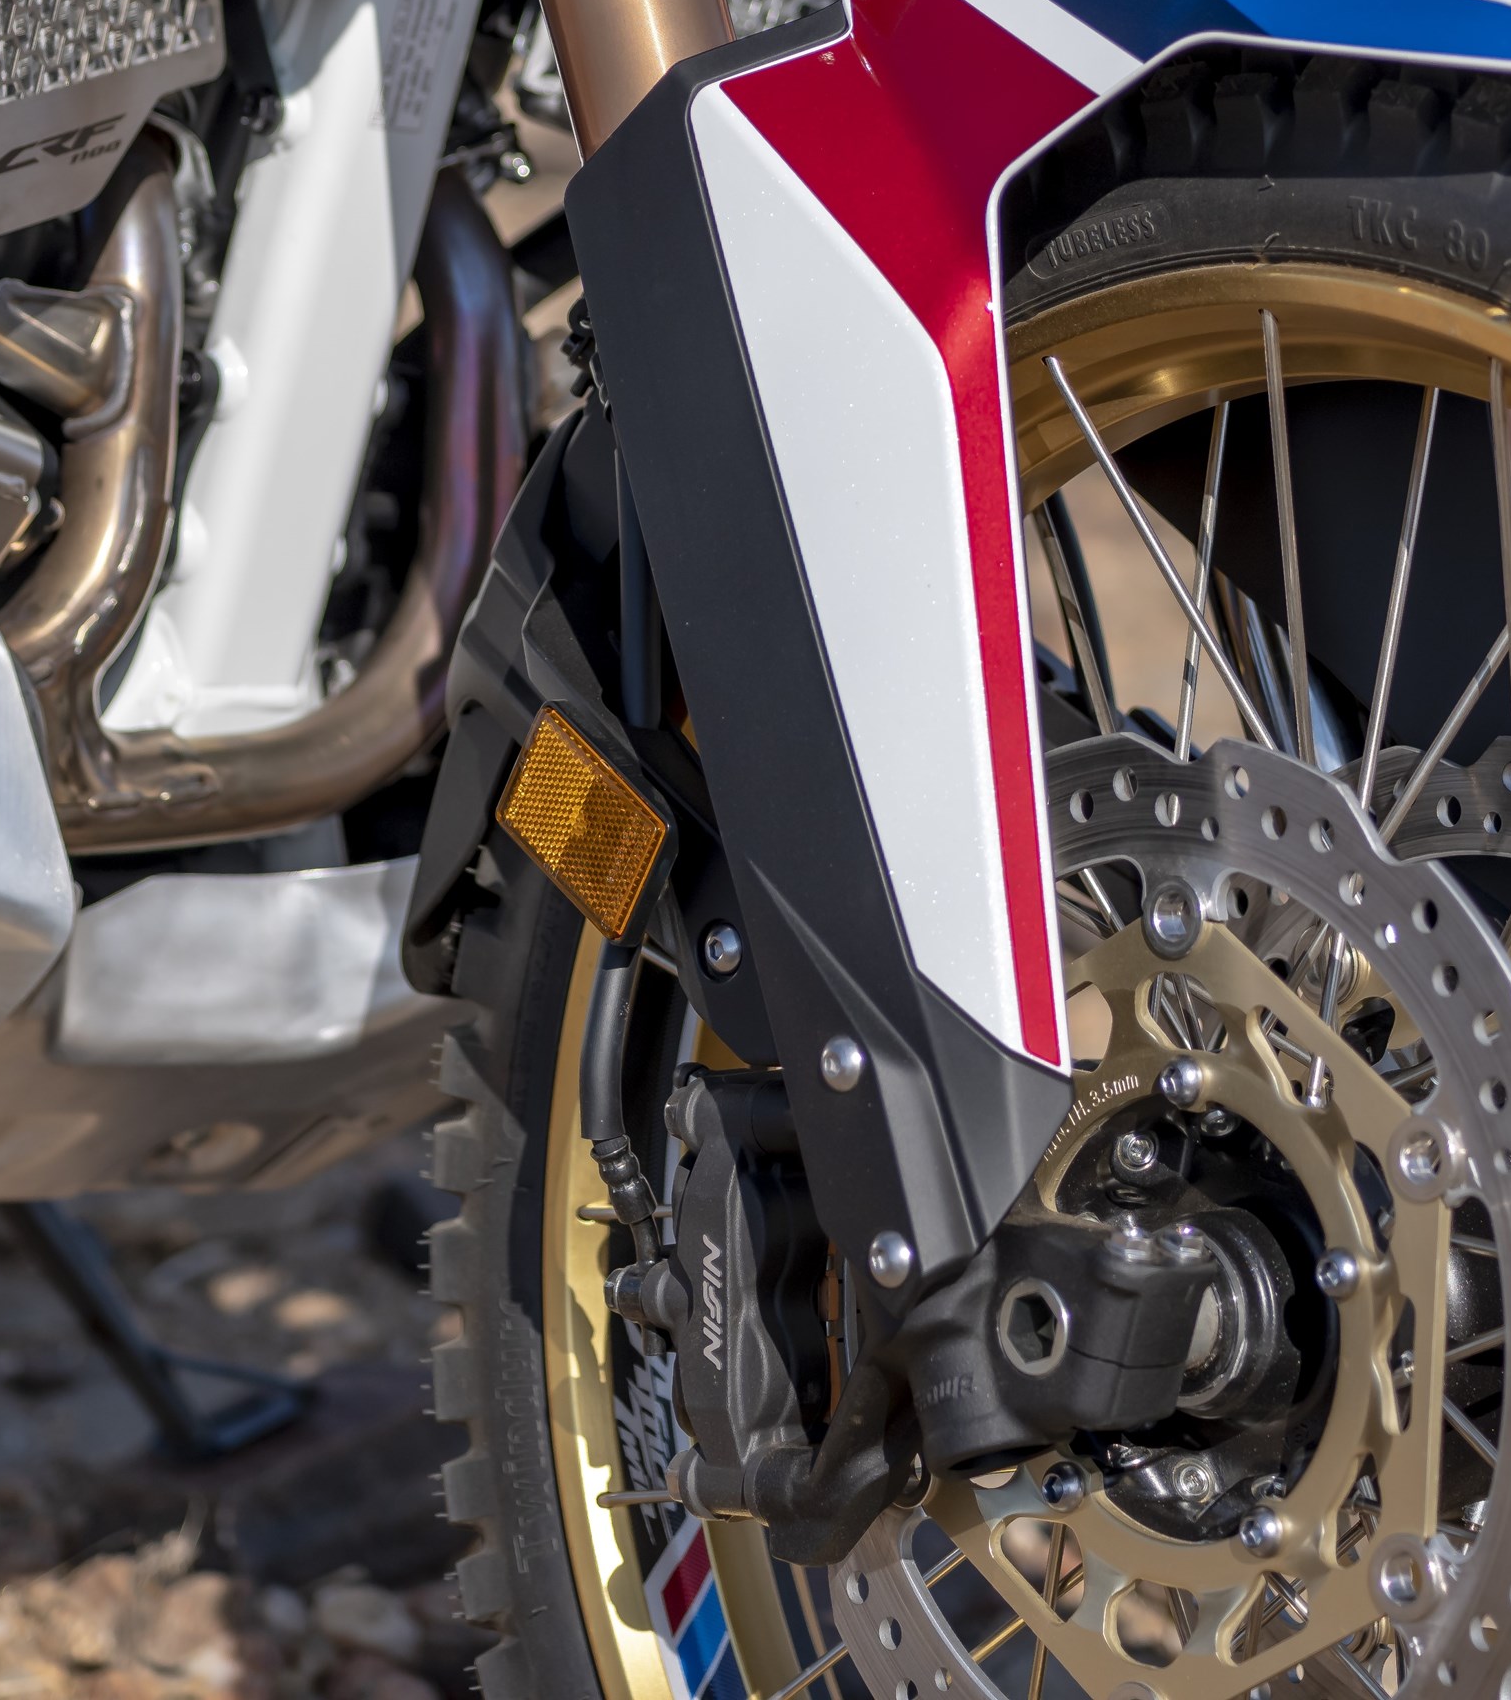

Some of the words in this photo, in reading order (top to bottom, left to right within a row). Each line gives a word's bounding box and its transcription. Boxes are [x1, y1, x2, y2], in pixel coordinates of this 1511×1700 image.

[69, 138, 123, 165] 1100
[1042, 207, 1159, 267] TUBELESS
[1347, 197, 1420, 251] TKC
[1442, 219, 1490, 270] 80
[700, 1234, 726, 1371] NISSIN
